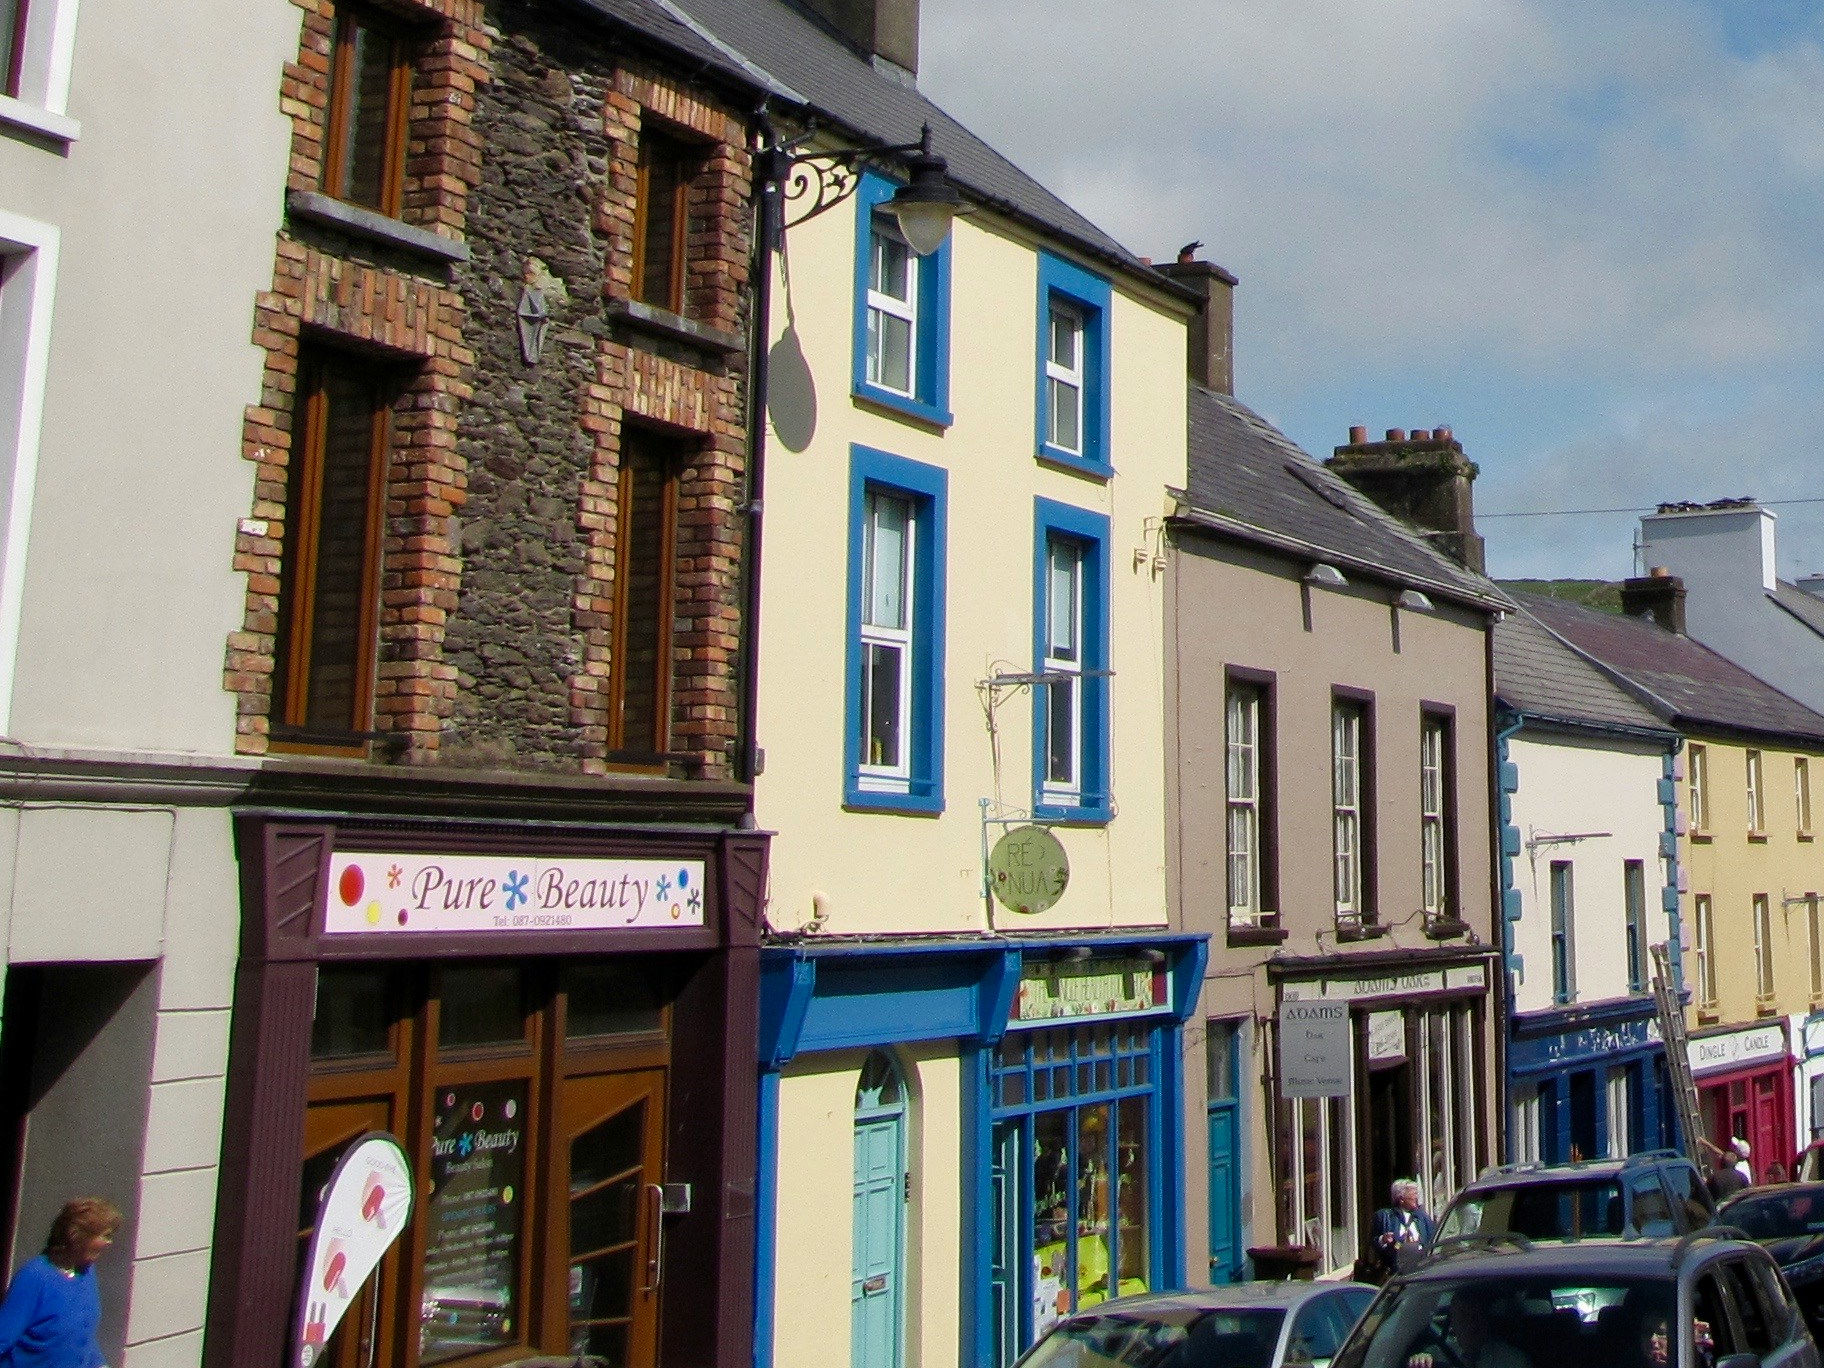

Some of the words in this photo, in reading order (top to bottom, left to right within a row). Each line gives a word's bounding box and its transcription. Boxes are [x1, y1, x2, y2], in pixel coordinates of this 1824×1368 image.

[412, 865, 497, 910] Pure
[537, 867, 649, 923] Beauty
[1008, 871, 1049, 895] NUA
[1286, 1006, 1344, 1021] ADAMS
[473, 1129, 520, 1154] Beauty
